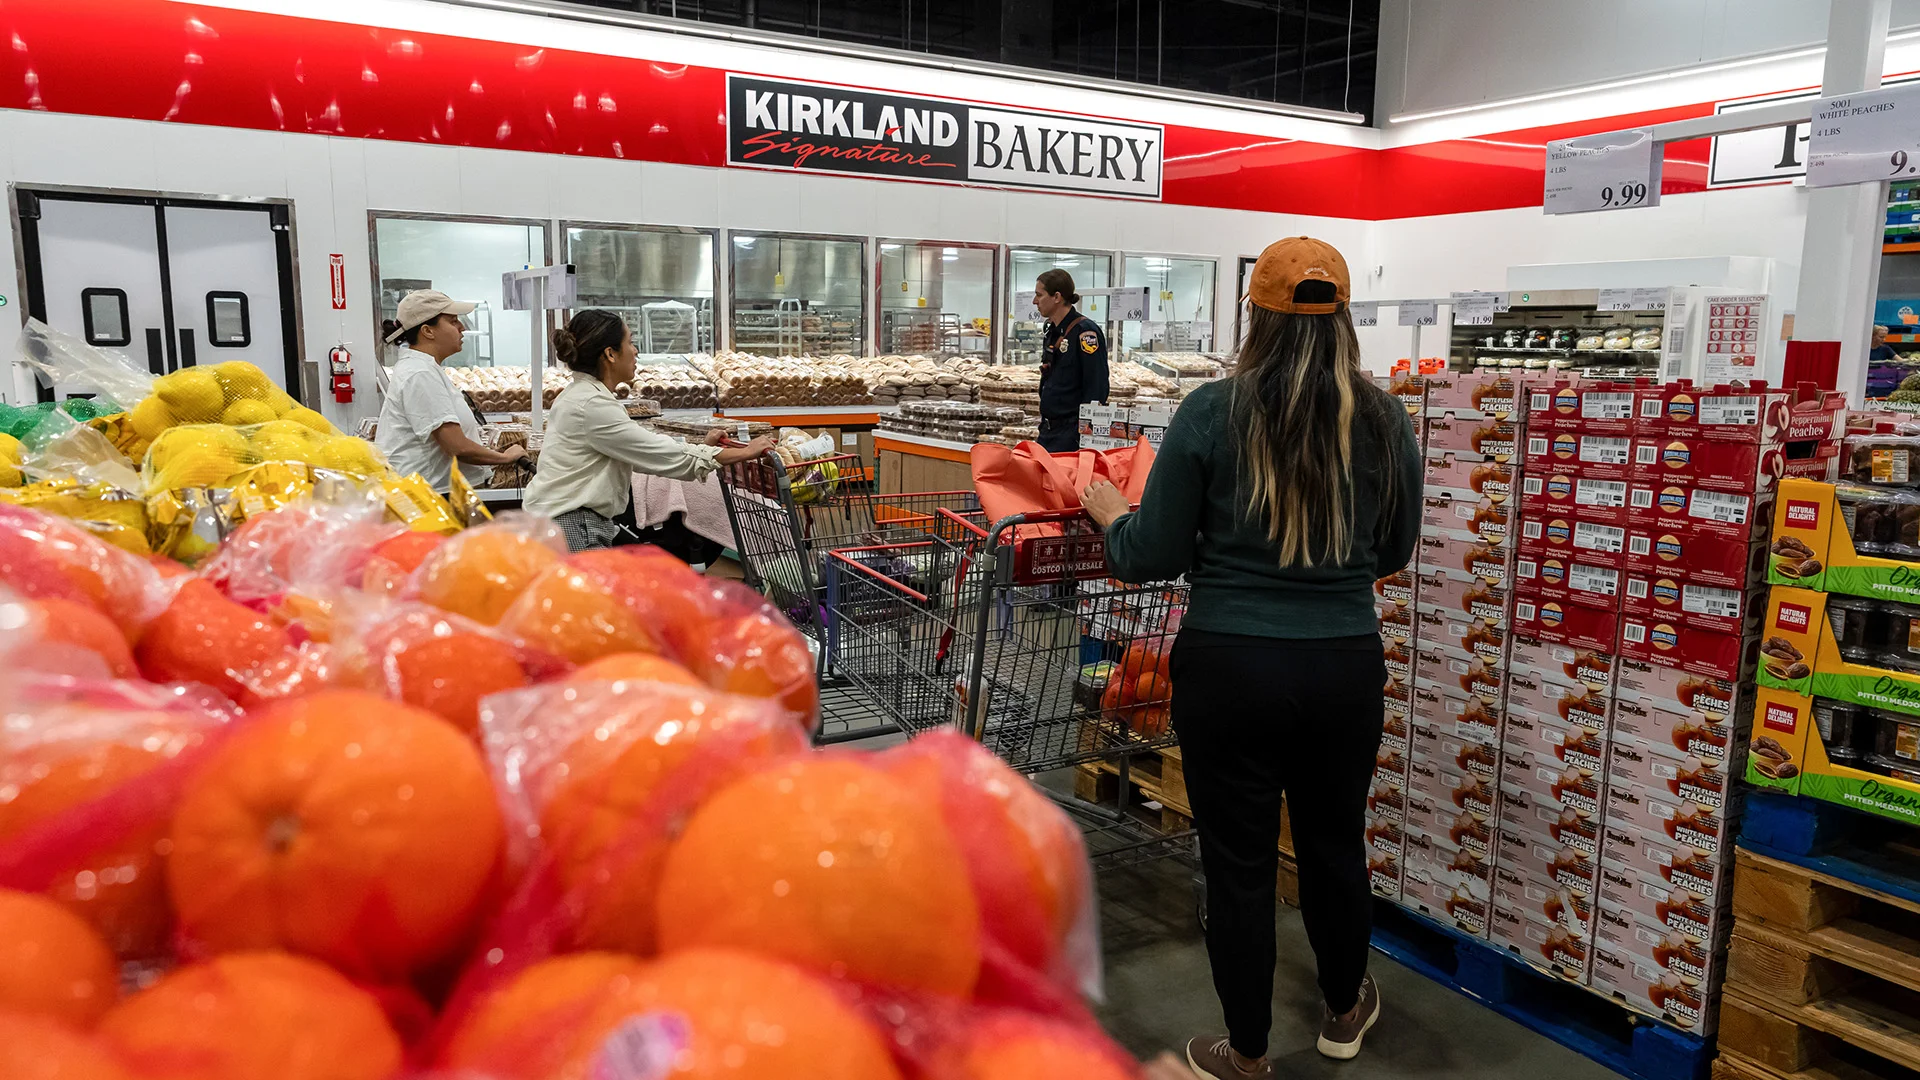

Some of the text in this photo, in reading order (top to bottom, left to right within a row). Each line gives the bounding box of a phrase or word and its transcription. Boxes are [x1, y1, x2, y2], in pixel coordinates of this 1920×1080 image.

[1820, 102, 1895, 119] WHITE PEACHES
[1831, 99, 1851, 109] 5001
[744, 89, 959, 147] KIRKLAND
[1824, 127, 1841, 136] LBS
[742, 130, 957, 168] Signature
[973, 119, 1154, 183] BAKERY
[1551, 152, 1577, 160] YELLOW
[1601, 184, 1646, 208] 9.99
[1028, 312, 1040, 320] 6.99
[1128, 309, 1142, 319] 6.99
[1417, 317, 1432, 325] 6.99
[1480, 403, 1513, 412] PEACHES
[1790, 424, 1823, 438] Peaches
[1480, 446, 1514, 455] PEACHES
[1483, 480, 1510, 490] PÊCHES
[1788, 512, 1815, 521] DELIGHTS
[1789, 506, 1815, 514] NATURAL
[1479, 521, 1506, 532] PÊCHES
[1032, 561, 1104, 575] COSTCO HLESALE
[1472, 567, 1504, 578] PEACHES
[1383, 590, 1411, 600] PEACHES
[1872, 583, 1904, 593] PITTED
[1471, 607, 1503, 619] PEACHES
[1780, 614, 1806, 625] DELIGHTS
[1781, 607, 1806, 619] NATURAL
[1382, 626, 1410, 638] PEACHES
[1474, 641, 1500, 654] PÊCHES
[1577, 665, 1608, 680] PÊCHES
[1472, 681, 1498, 694] PÊCHES
[1693, 693, 1730, 710] PÊCHES
[1858, 692, 1888, 702] PITTED
[1384, 702, 1408, 714] EACHES
[1768, 707, 1794, 720] NATURAL
[1568, 714, 1604, 730] PEACHES
[1767, 714, 1794, 726] DELIGHTS
[1688, 739, 1724, 755] PÊCHES
[1564, 755, 1600, 772] PEACHES
[1680, 782, 1721, 799] WHITE FLESH
[1561, 795, 1596, 813] PEACHES
[1678, 789, 1721, 808] PEACHES
[1844, 793, 1917, 817] PITTED MEDJOOL
[1676, 825, 1717, 843] WHITE FLESH
[1560, 836, 1595, 853] PEACHES
[1675, 832, 1717, 852] PEACHES
[1557, 875, 1592, 894] PEACHES
[1671, 869, 1713, 888] WHITE FLESH
[1671, 876, 1712, 897] PEACHES
[1454, 910, 1484, 928] PEACHES
[1668, 912, 1709, 931] WHITE FLESH
[1667, 918, 1708, 940] PEACHES
[1668, 956, 1703, 976] PÊCHES
[1664, 997, 1699, 1018] PÊCHES
